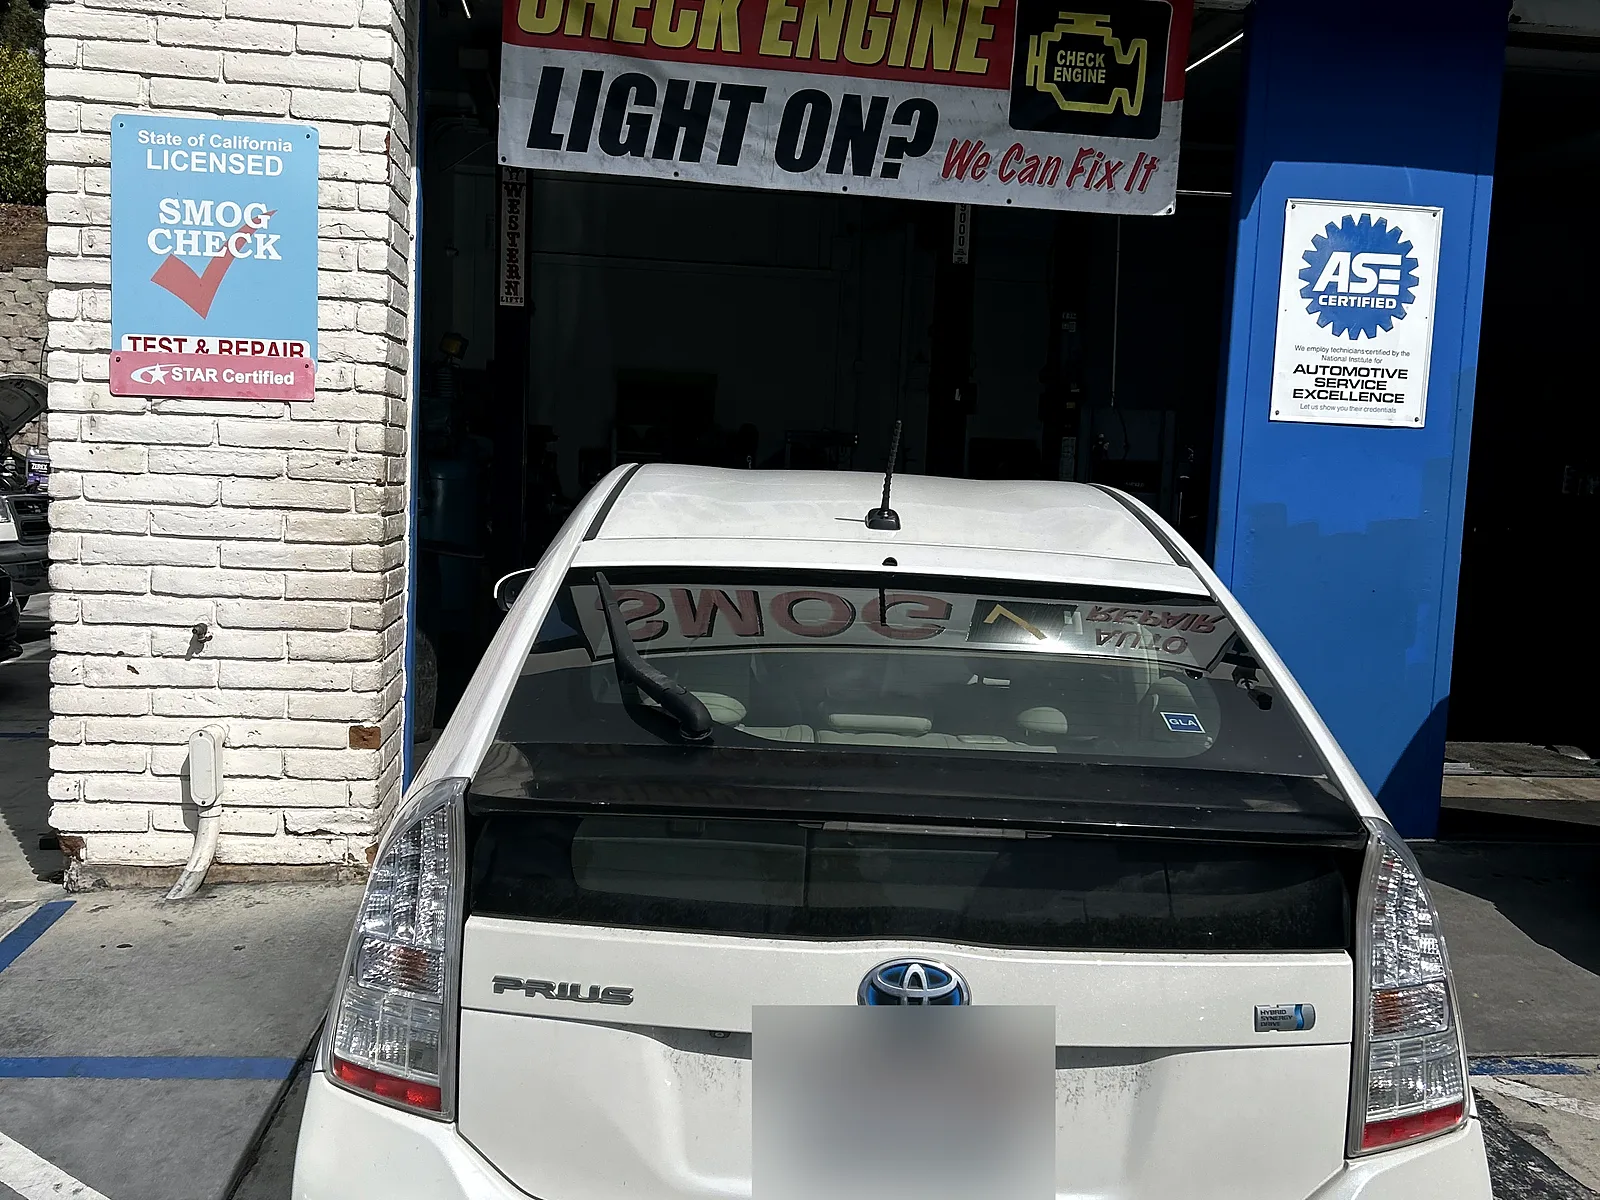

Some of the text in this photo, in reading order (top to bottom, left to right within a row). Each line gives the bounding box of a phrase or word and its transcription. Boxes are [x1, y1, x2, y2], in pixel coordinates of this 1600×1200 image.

[758, 0, 1000, 74] ENGINE
[1056, 49, 1106, 69] CHECK
[1053, 65, 1106, 85] ENGINE
[525, 65, 940, 180] LIGHT ON?
[137, 129, 293, 153] State of California
[146, 149, 284, 177] LICENSED
[940, 137, 1160, 195] We Can Fix It
[158, 197, 271, 229] SMOG
[147, 228, 282, 261] CHECK
[502, 181, 525, 297] WESTERN
[1312, 251, 1403, 296] ASE
[1318, 294, 1397, 310] CERTIFIED
[127, 336, 305, 358] TEST & REPAIR
[1294, 344, 1306, 352] We
[1306, 346, 1330, 354] employ
[1330, 346, 1365, 355] technicians
[1365, 348, 1391, 356] certified
[1391, 350, 1400, 358] by
[1321, 354, 1347, 362] National
[1348, 356, 1373, 364] Institute
[171, 367, 295, 386] STAR Certified
[1292, 363, 1409, 379] AUTOMOTIVE
[1314, 377, 1388, 391] SERVICE
[1292, 389, 1405, 404] EXCELLENCE
[1168, 718, 1198, 727] GLA
[491, 975, 635, 1006] PRIUS
